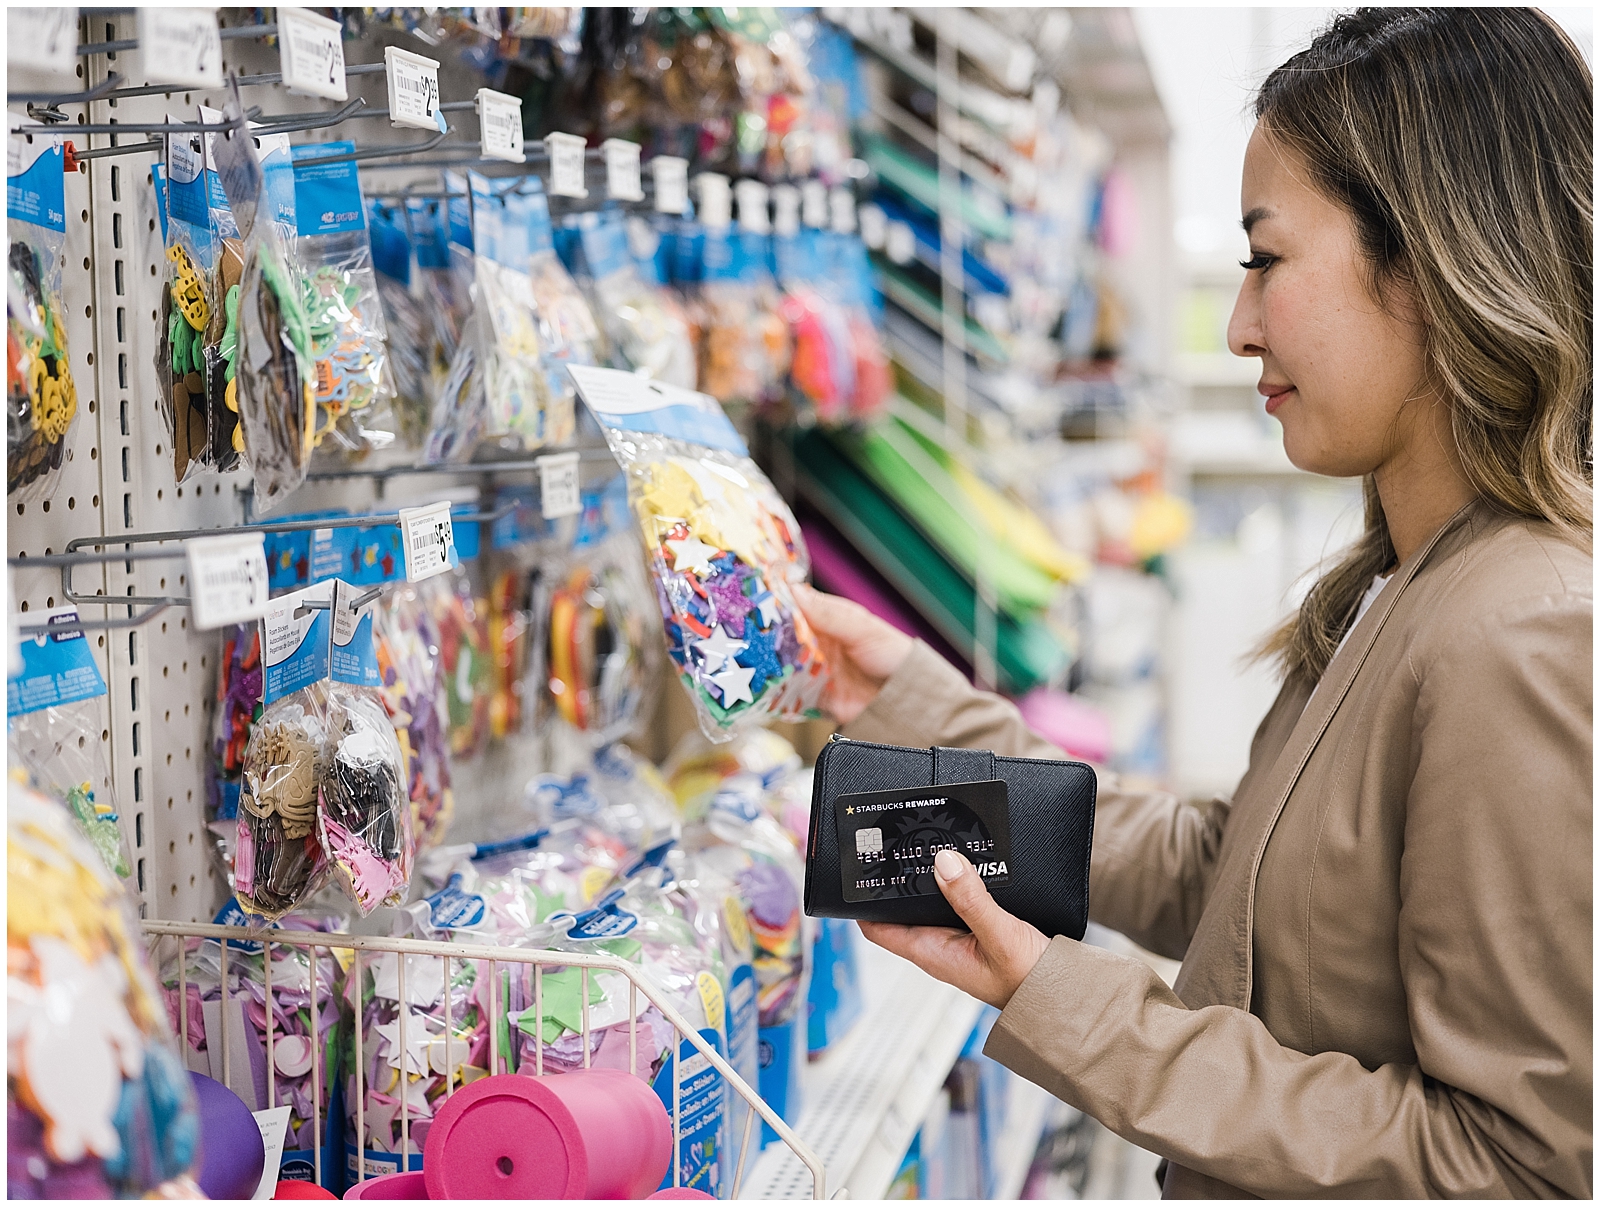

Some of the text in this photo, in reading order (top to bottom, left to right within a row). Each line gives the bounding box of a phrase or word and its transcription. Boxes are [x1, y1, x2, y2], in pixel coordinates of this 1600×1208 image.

[856, 802, 904, 813] STARBUCKS
[856, 850, 886, 864] 4291
[893, 846, 922, 860] 6110
[966, 839, 995, 853] 9314
[972, 861, 1008, 876] VISA
[855, 875, 906, 889] ANGELA KIM
